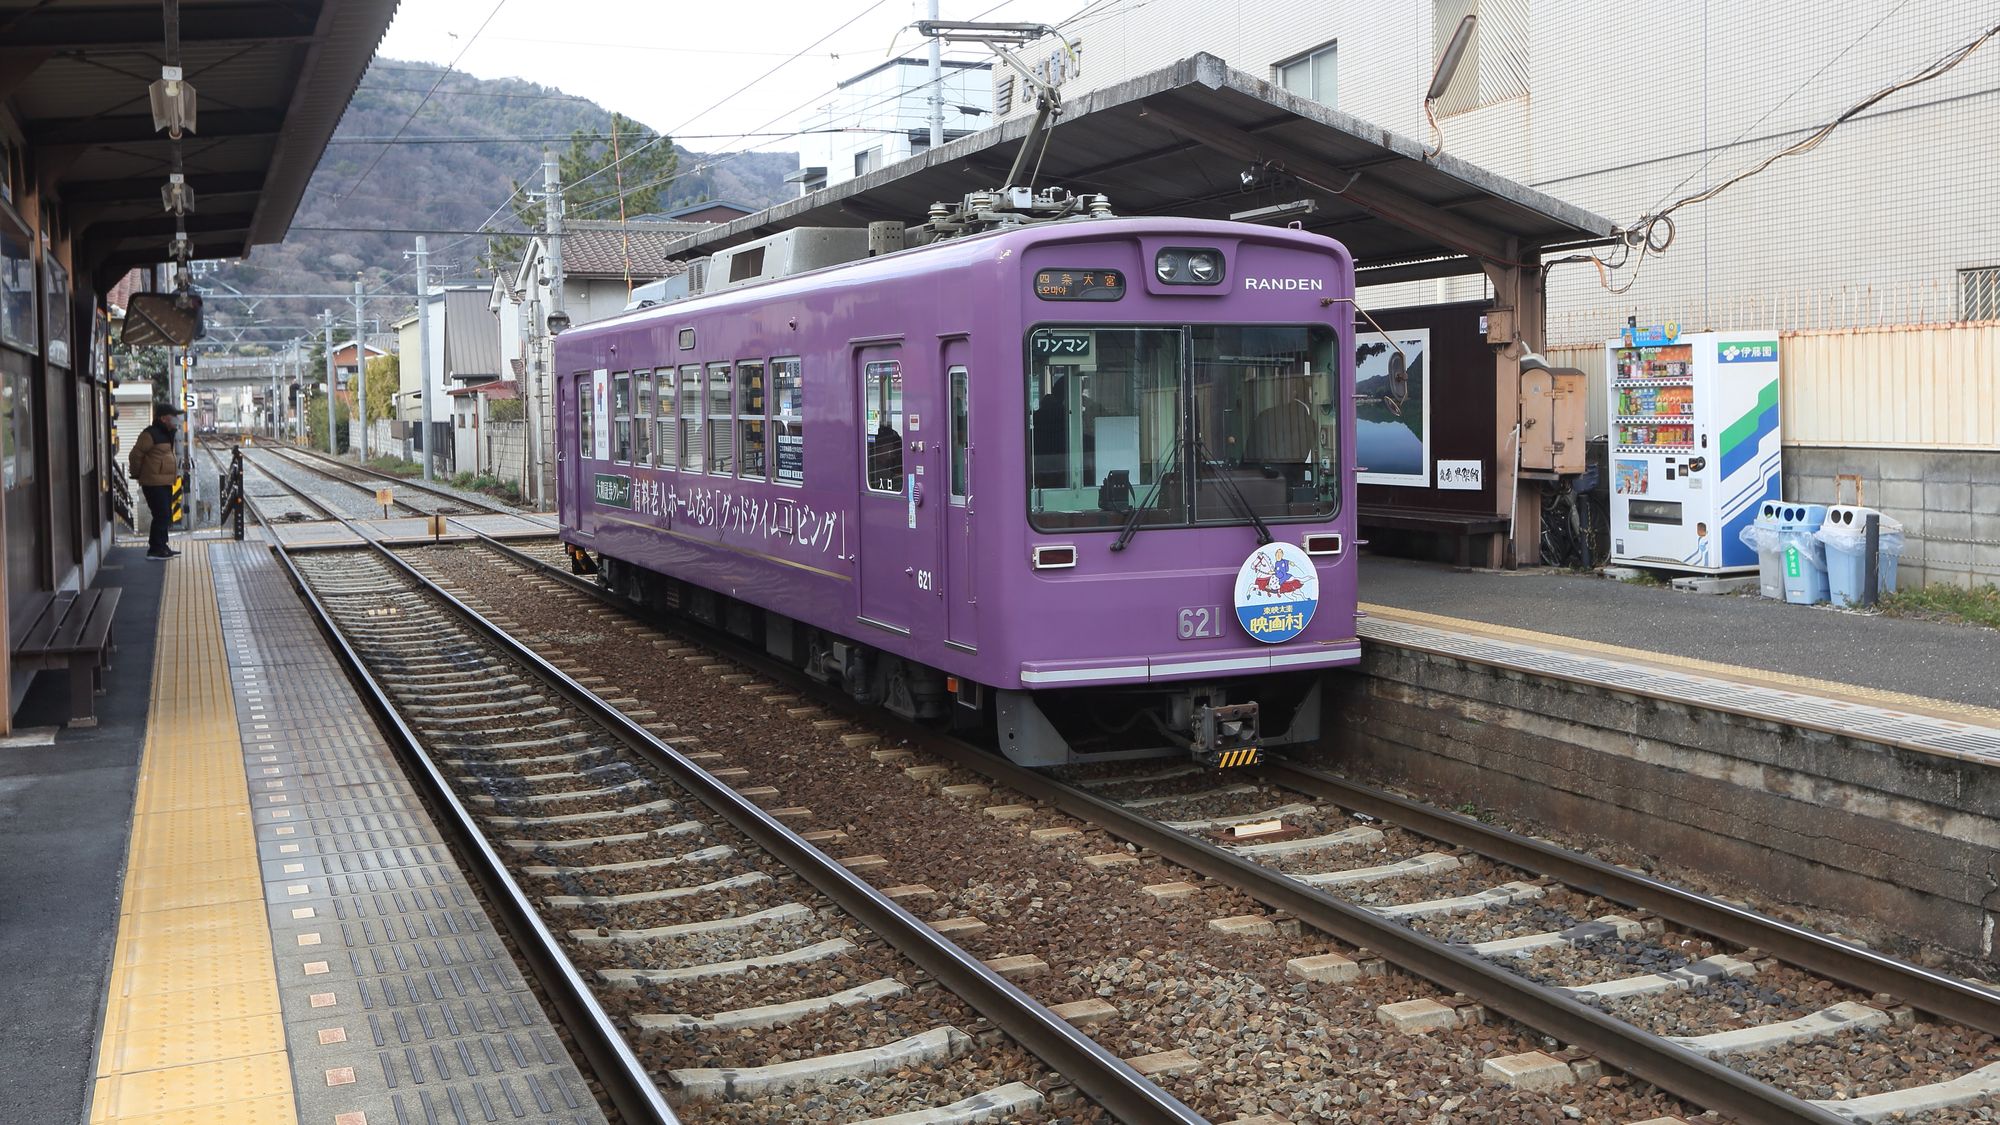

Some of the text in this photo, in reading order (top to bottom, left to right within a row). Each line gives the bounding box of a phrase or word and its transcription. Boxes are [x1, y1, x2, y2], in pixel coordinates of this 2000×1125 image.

[1039, 274, 1116, 287] 四条大宮
[1245, 278, 1323, 290] RANDEN
[1037, 286, 1066, 295] 오미야
[1037, 338, 1088, 352] ワンマン
[1741, 346, 1772, 358] 伊藤園
[879, 478, 893, 490] 入口
[918, 569, 932, 591] 621
[1179, 607, 1220, 638] 621
[1250, 612, 1304, 634] 映画村
